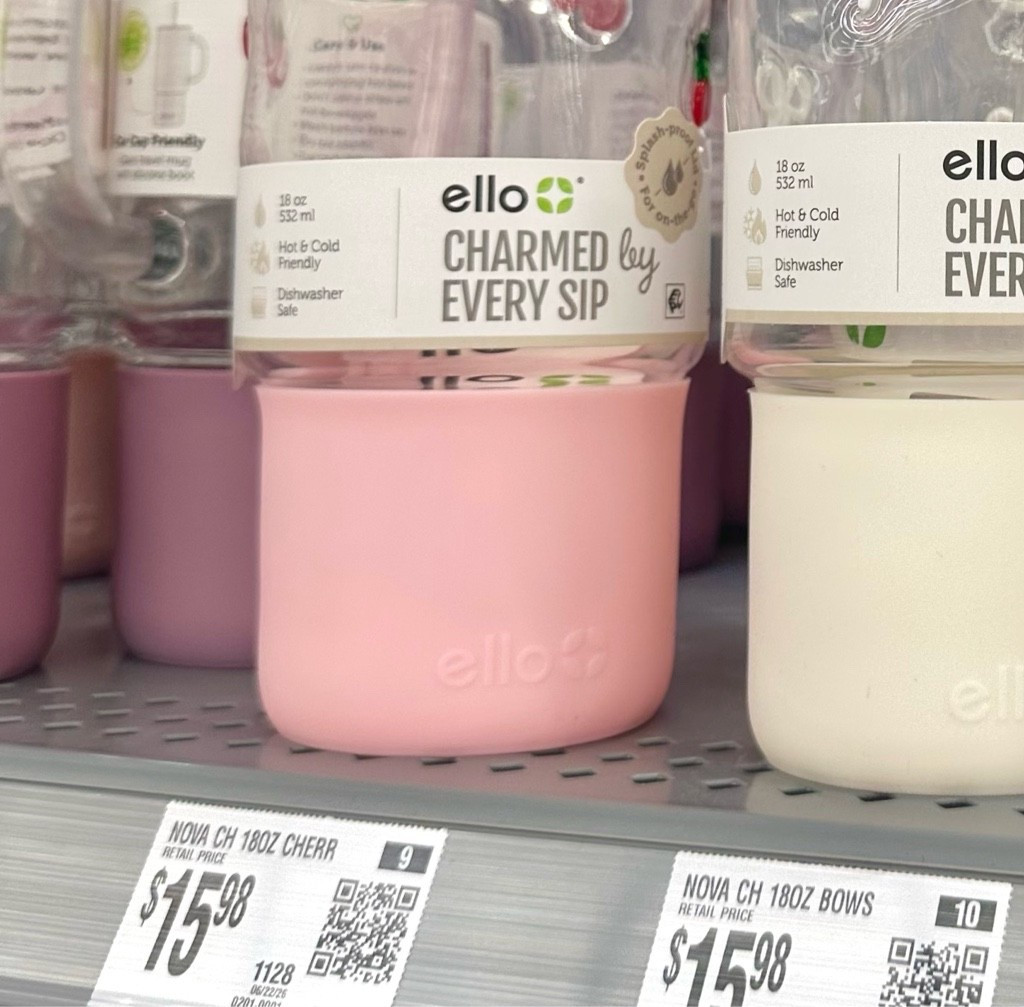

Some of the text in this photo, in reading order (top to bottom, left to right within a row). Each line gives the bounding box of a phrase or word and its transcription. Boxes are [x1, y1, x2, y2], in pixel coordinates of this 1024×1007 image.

[776, 159, 805, 173] 18 oz
[776, 175, 814, 190] 532 ml
[280, 194, 307, 207] 18 oz
[442, 175, 529, 213] ello
[280, 209, 315, 223] 532 ml
[776, 207, 839, 222] Hot & Cold
[775, 225, 820, 242] Friendly
[279, 239, 340, 253] Hot & Cold
[279, 256, 321, 272] Friendly
[444, 227, 660, 293] CHARMED by
[775, 257, 843, 272] Dishwasher
[775, 274, 796, 288] Safe
[278, 287, 344, 301] Dishwasher
[442, 278, 609, 322] EVERY SIP
[278, 304, 298, 317] Safe
[437, 632, 549, 687] ello
[168, 820, 208, 847] NOVA
[213, 826, 239, 850] CH
[283, 834, 339, 861] CHERR
[162, 845, 228, 865] RETAIL PRICE
[398, 845, 413, 870] 9
[683, 874, 730, 902] NOVA
[737, 879, 763, 905] CH
[818, 888, 875, 916] BOWS
[678, 902, 754, 922] RETAIL PRICE
[954, 901, 980, 928] 10
[254, 960, 295, 985] 1128
